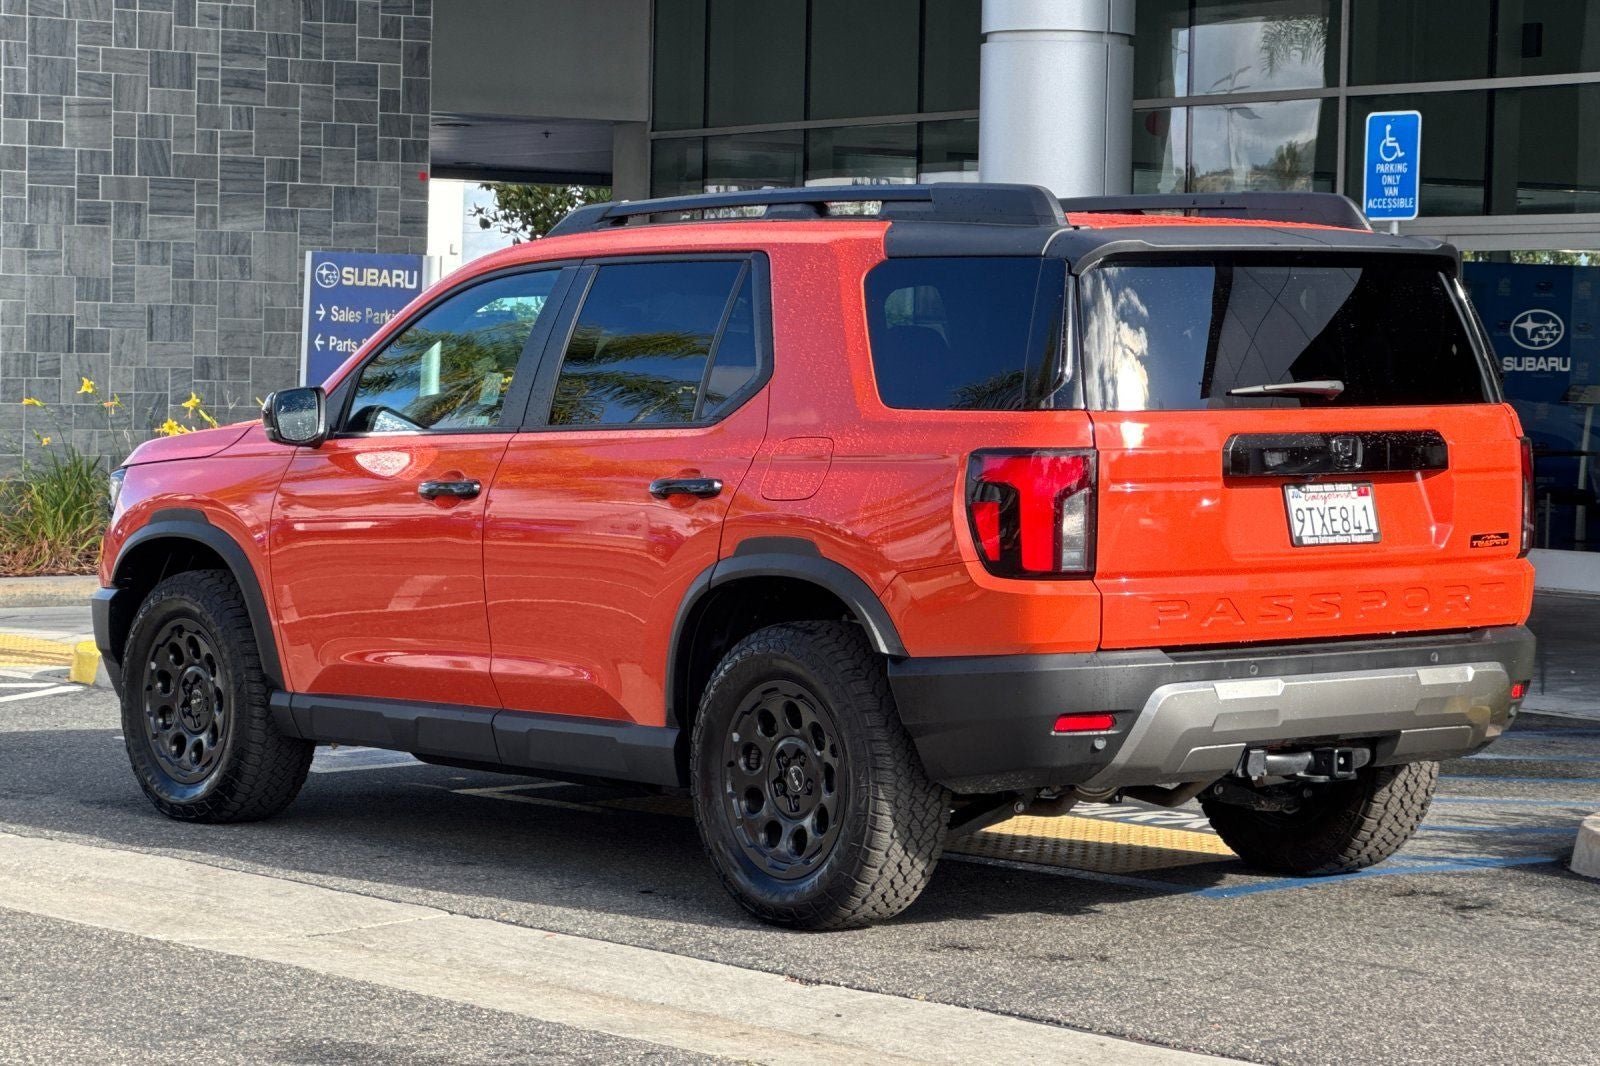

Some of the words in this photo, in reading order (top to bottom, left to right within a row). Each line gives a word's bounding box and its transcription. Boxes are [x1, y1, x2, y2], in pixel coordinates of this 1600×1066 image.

[1376, 163, 1407, 173] PARKING
[1382, 175, 1401, 185] ONLY
[1384, 186, 1398, 196] VAN
[1368, 198, 1414, 209] ACCESSIBLE
[342, 267, 417, 289] SUBARU
[331, 306, 362, 323] Sales
[365, 307, 396, 324] Parki
[329, 336, 358, 352] Parts
[1502, 356, 1571, 372] SUBARU
[1295, 505, 1374, 536] 9TXE841
[1150, 581, 1506, 629] PASSPORT
